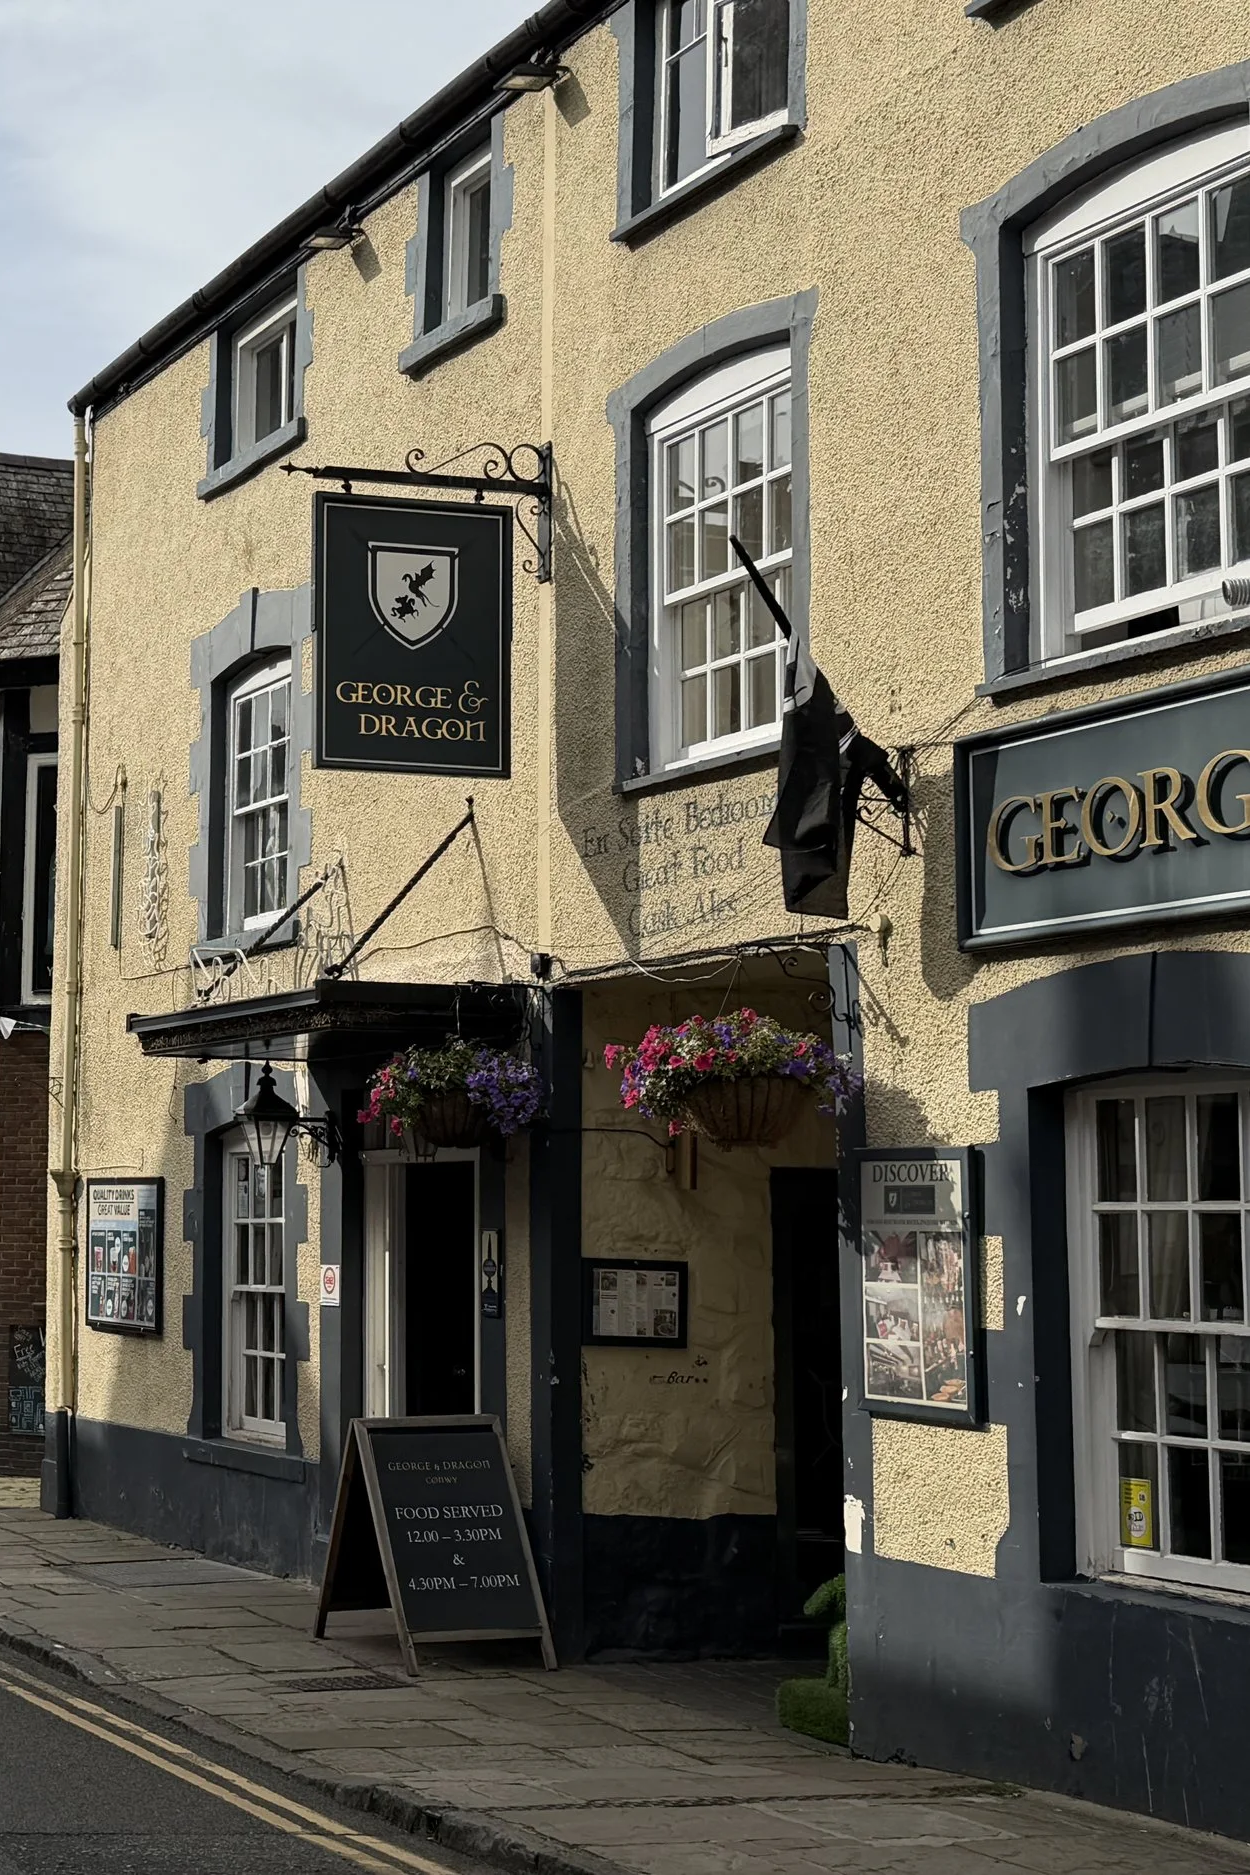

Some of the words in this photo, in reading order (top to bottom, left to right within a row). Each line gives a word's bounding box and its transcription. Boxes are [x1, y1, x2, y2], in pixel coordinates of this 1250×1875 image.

[336, 681, 452, 709] GEORGE
[458, 680, 489, 714] &
[358, 713, 487, 742] DRAGON
[691, 838, 745, 877] Food
[872, 1163, 950, 1183] DISCOVER
[93, 1189, 115, 1201] QUALITY
[115, 1189, 135, 1201] DRINKS
[97, 1204, 114, 1216] GREAT
[114, 1204, 131, 1216] VALUE
[388, 1461, 431, 1472] GEORGE
[442, 1460, 491, 1471] DRAGON
[425, 1476, 458, 1485] CONWY
[395, 1506, 440, 1520] FOOD
[442, 1504, 503, 1519] SERVED
[407, 1529, 440, 1543] 12.00
[453, 1527, 503, 1542] 3.30PM
[452, 1553, 466, 1566] &
[408, 1576, 457, 1591] 4.30PM
[470, 1574, 521, 1589] 7.00PM
